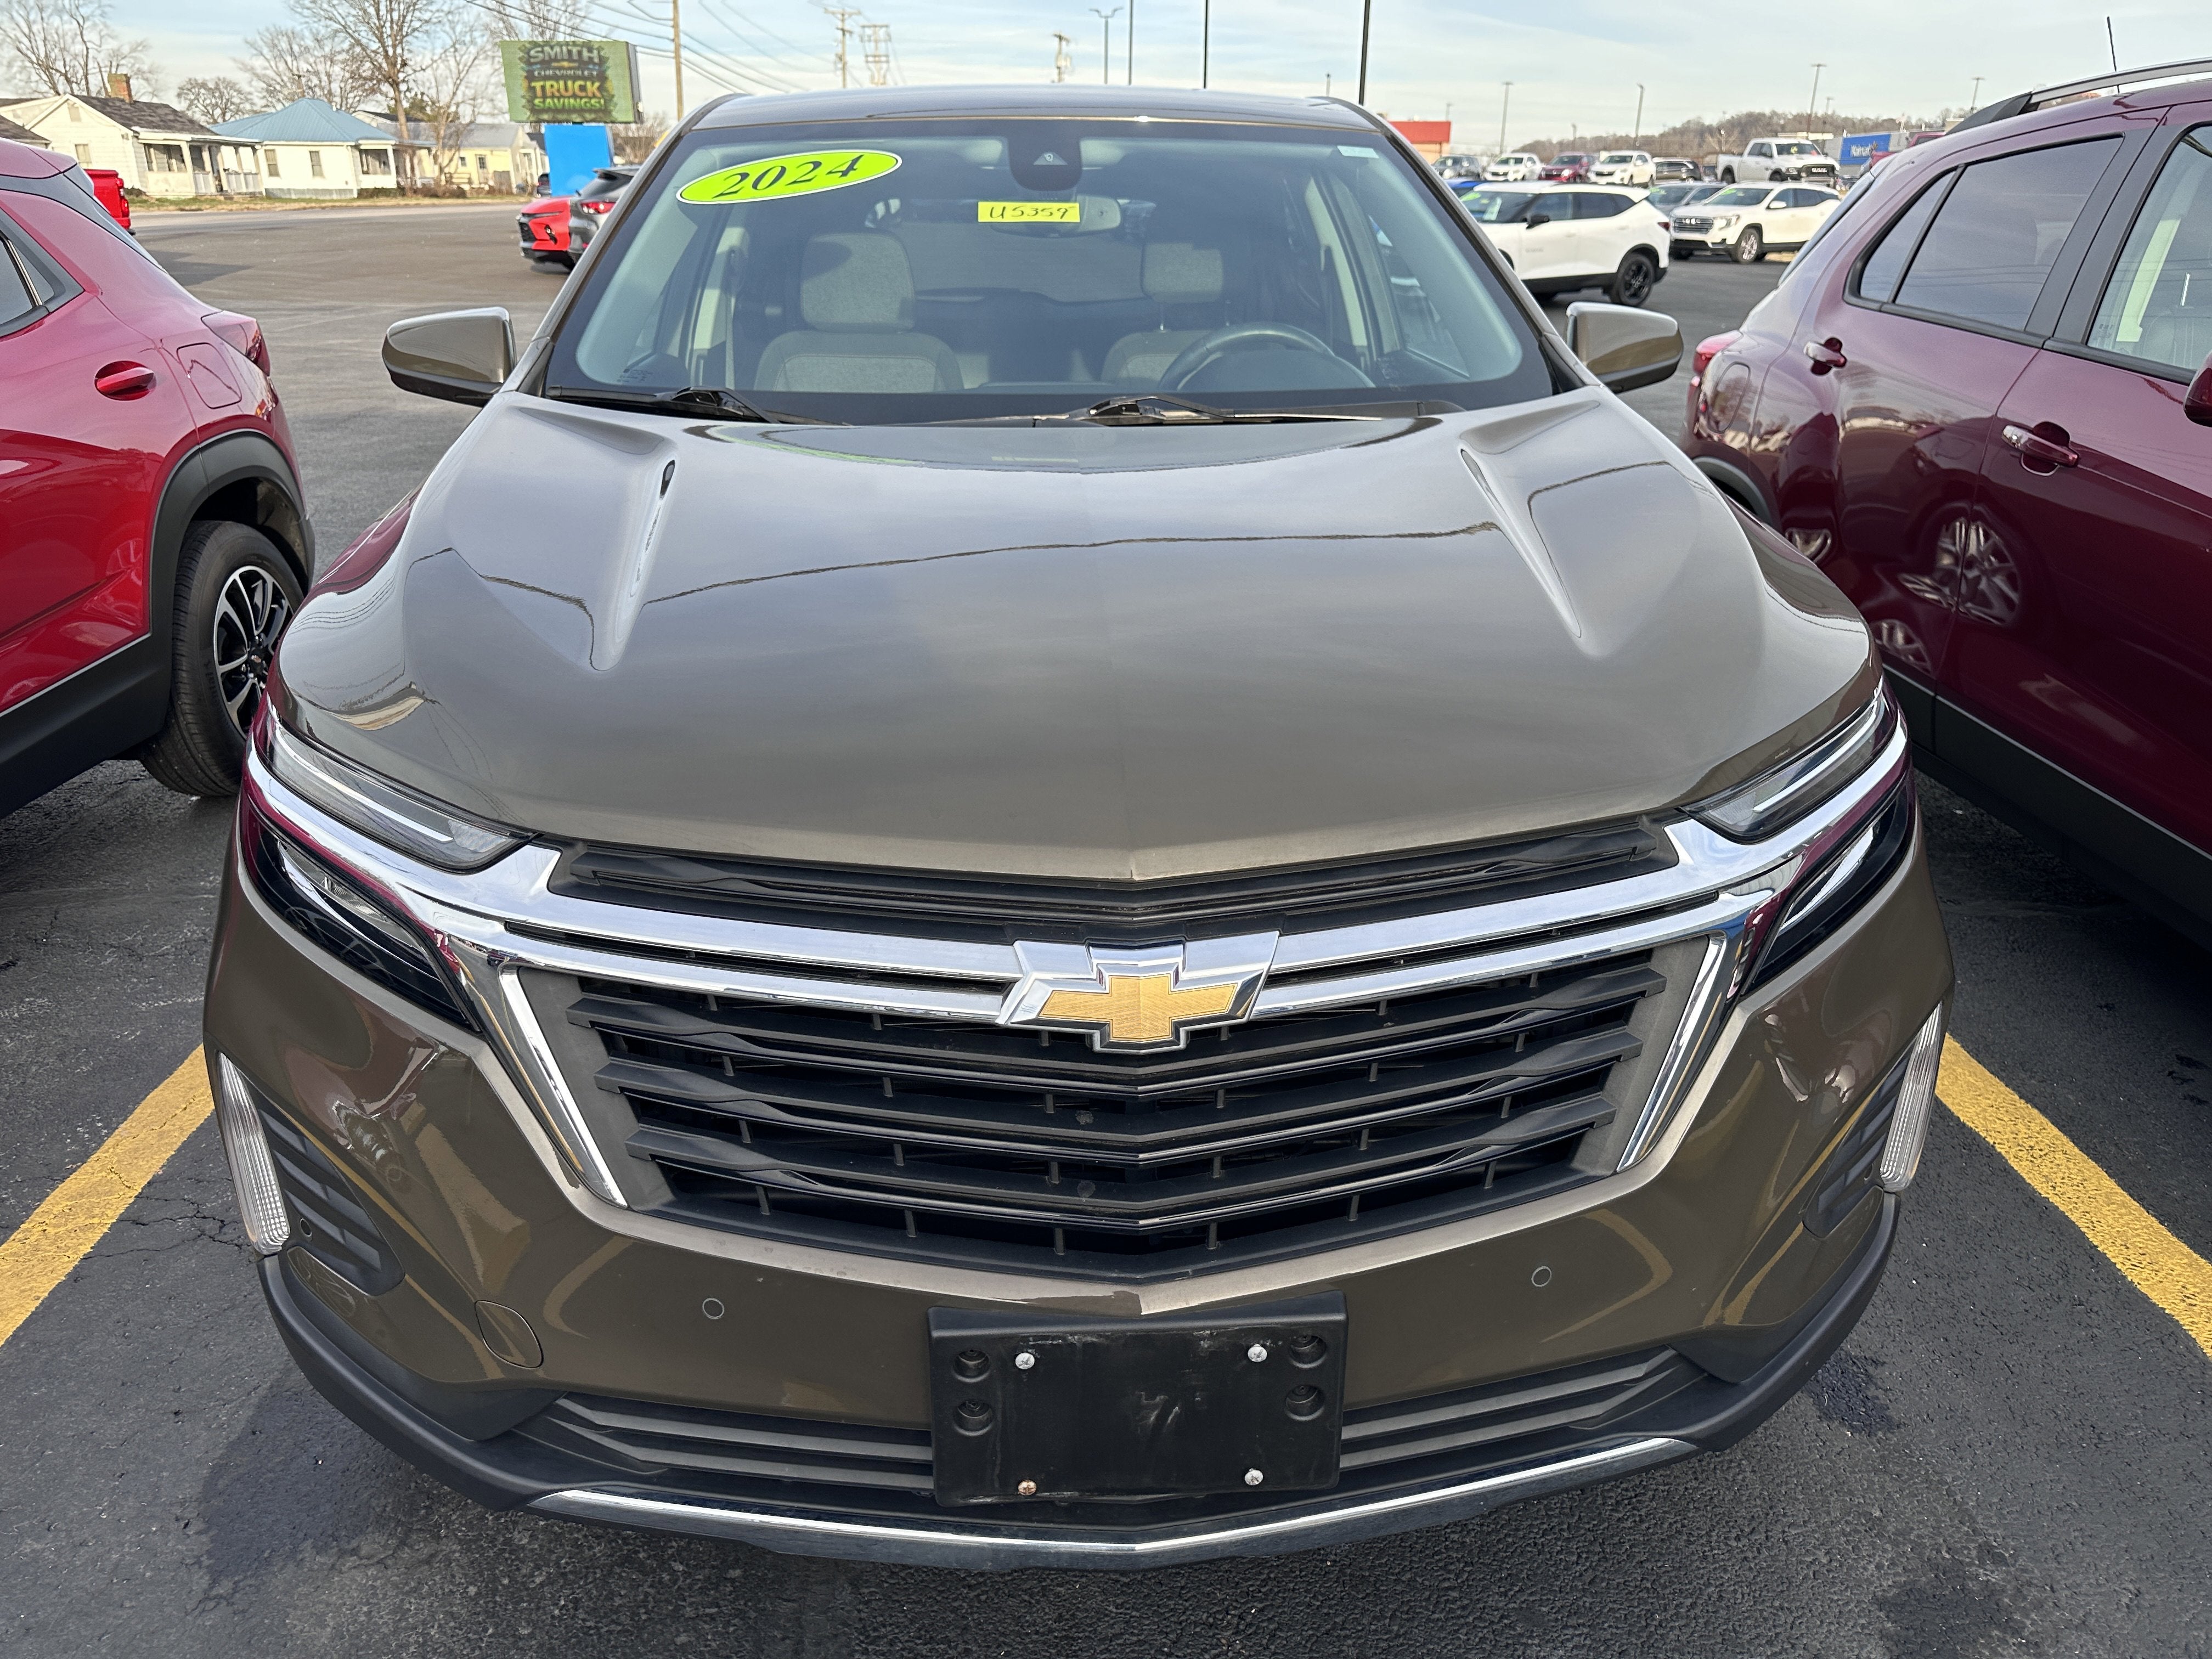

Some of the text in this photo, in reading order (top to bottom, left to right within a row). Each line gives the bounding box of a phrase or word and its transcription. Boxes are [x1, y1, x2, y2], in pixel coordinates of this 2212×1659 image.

[529, 46, 600, 63] SMITH
[531, 80, 602, 97] TRUCK
[533, 98, 605, 109] SAVINGS!
[712, 154, 865, 199] 2024
